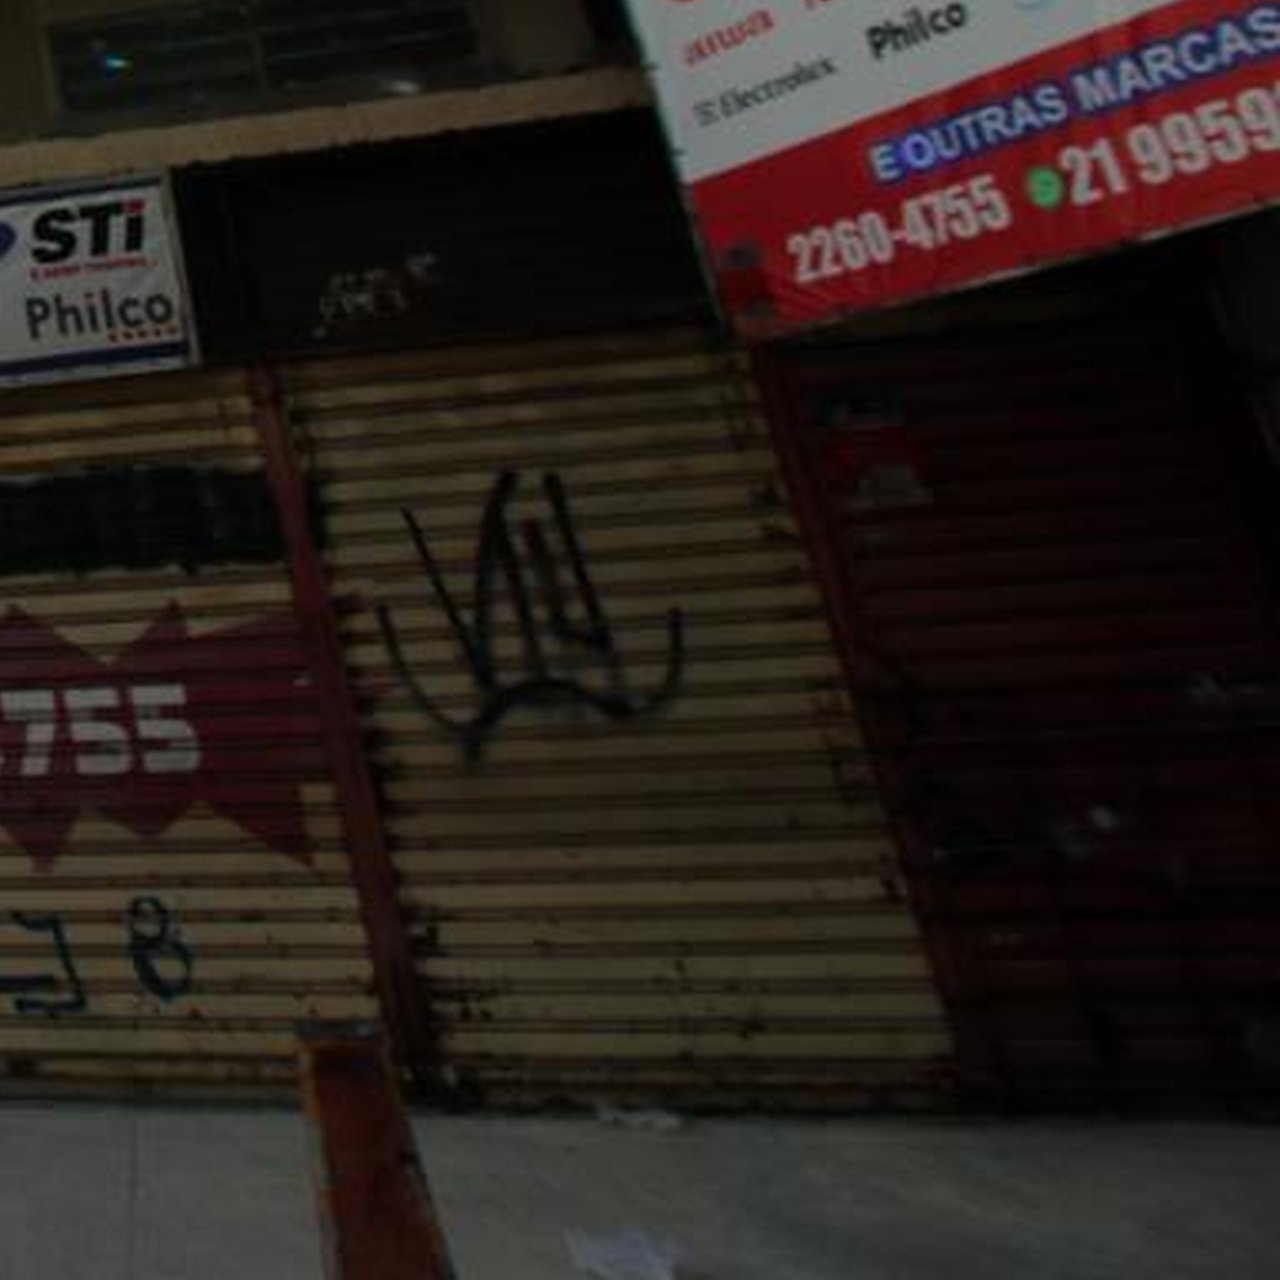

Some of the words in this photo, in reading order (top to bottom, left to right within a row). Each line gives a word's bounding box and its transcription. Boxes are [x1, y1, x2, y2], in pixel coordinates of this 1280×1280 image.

[868, 2, 968, 59] Philco
[903, 85, 1068, 168] OUTRAS
[1071, 7, 1280, 110] MARCAS
[786, 174, 1014, 284] 2260-4755
[1058, 137, 1128, 206] 21
[1127, 81, 1280, 185] 9959
[27, 289, 172, 339] Philco
